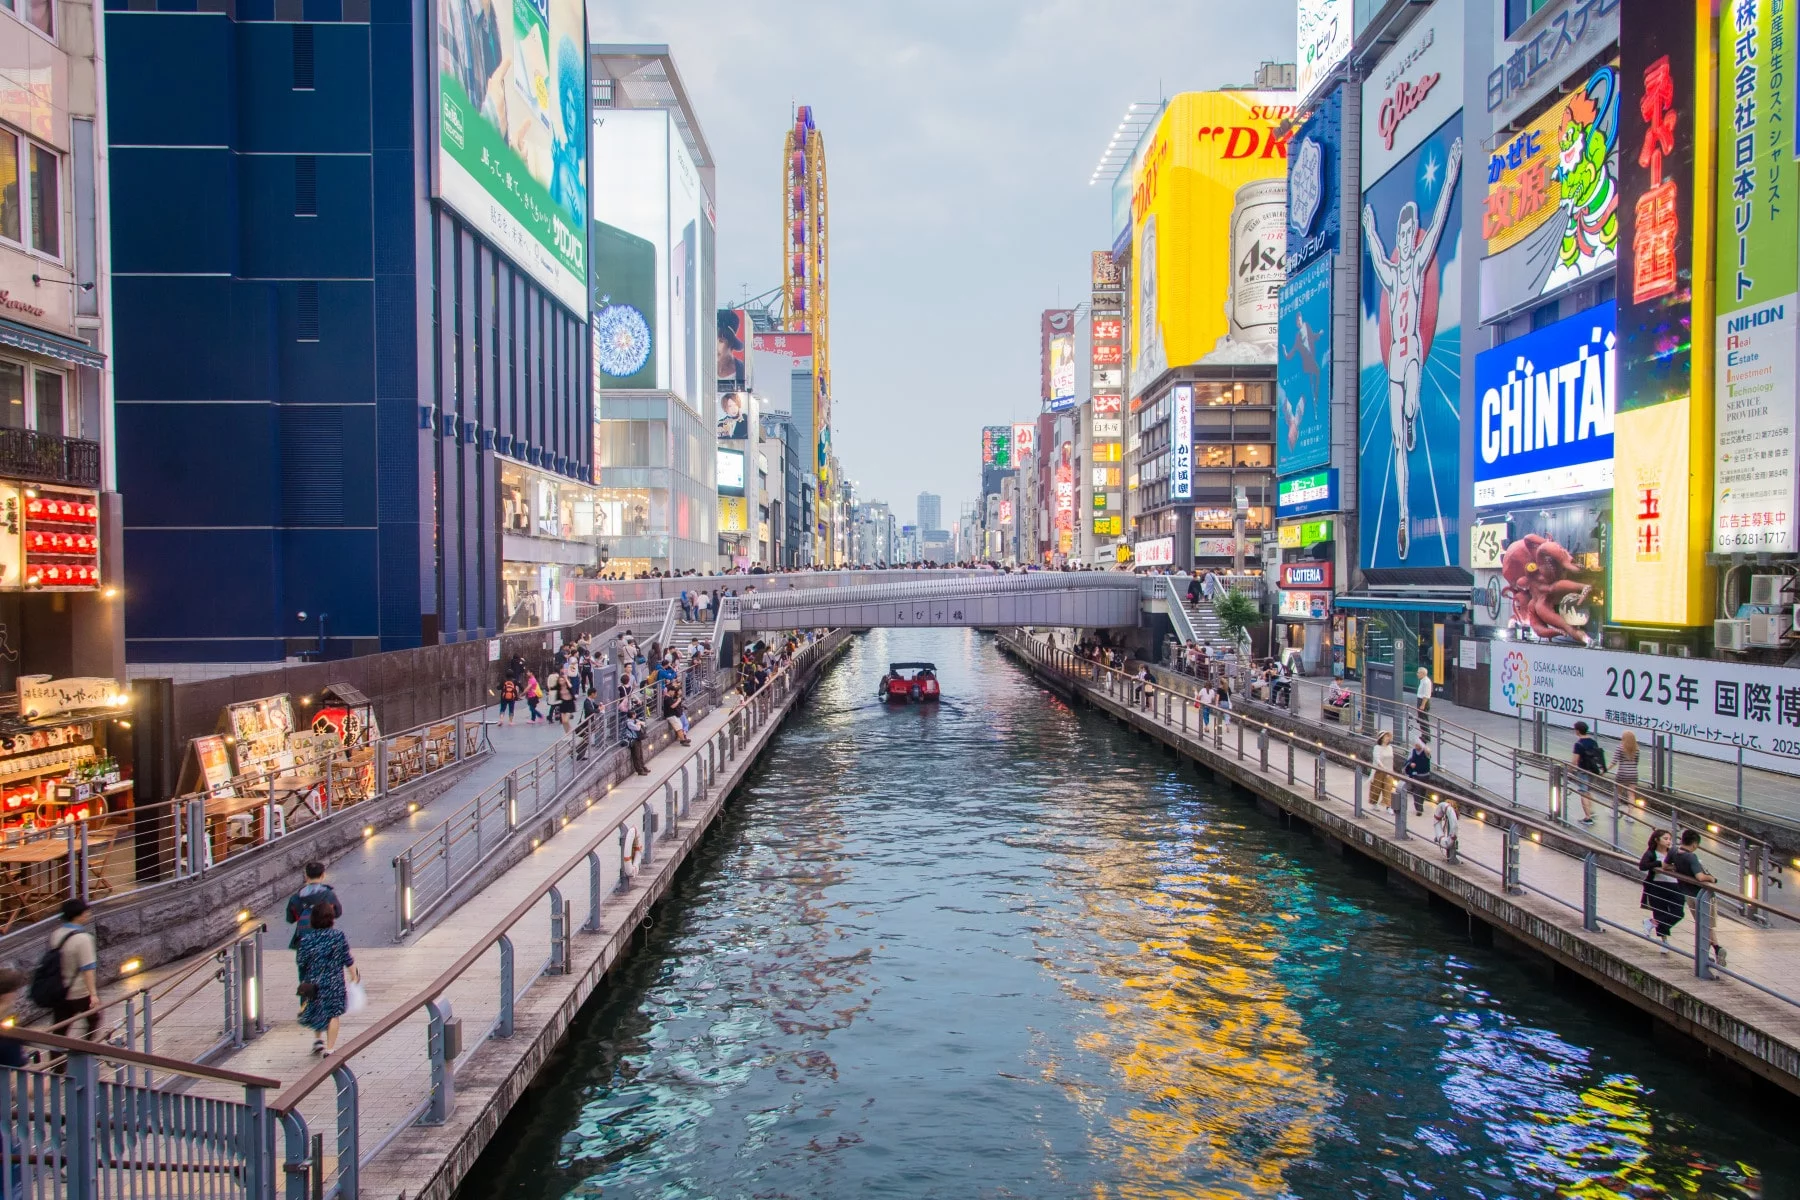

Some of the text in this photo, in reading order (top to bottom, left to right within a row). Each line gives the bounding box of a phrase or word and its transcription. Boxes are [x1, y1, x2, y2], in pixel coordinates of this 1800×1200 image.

[1378, 72, 1440, 150] Glico
[1488, 130, 1541, 185] かぜに
[1734, 0, 1757, 300] 株式会社日本リート
[1482, 156, 1547, 240] 改源
[1727, 305, 1784, 335] NIHON
[1727, 335, 1751, 351] Real
[1727, 350, 1760, 367] Estate
[1726, 365, 1773, 384] Investment
[1726, 382, 1774, 399] Technology
[1726, 396, 1761, 412] SERVICE
[1726, 406, 1769, 422] PROVIDER
[1719, 510, 1786, 528] 広告主募集中
[1718, 532, 1787, 546] 06-6281-1717
[1293, 568, 1321, 582] LOTTERIA
[898, 610, 963, 620] えびす橋
[1533, 660, 1584, 678] OSAKA-KANSAI
[1533, 676, 1554, 689] JAPAN
[1533, 691, 1584, 715] EXPO2025
[1605, 667, 1800, 729] 2025年 国際博
[1605, 709, 1763, 749] 南海電鉄はオフィシャルパートナーとして、
